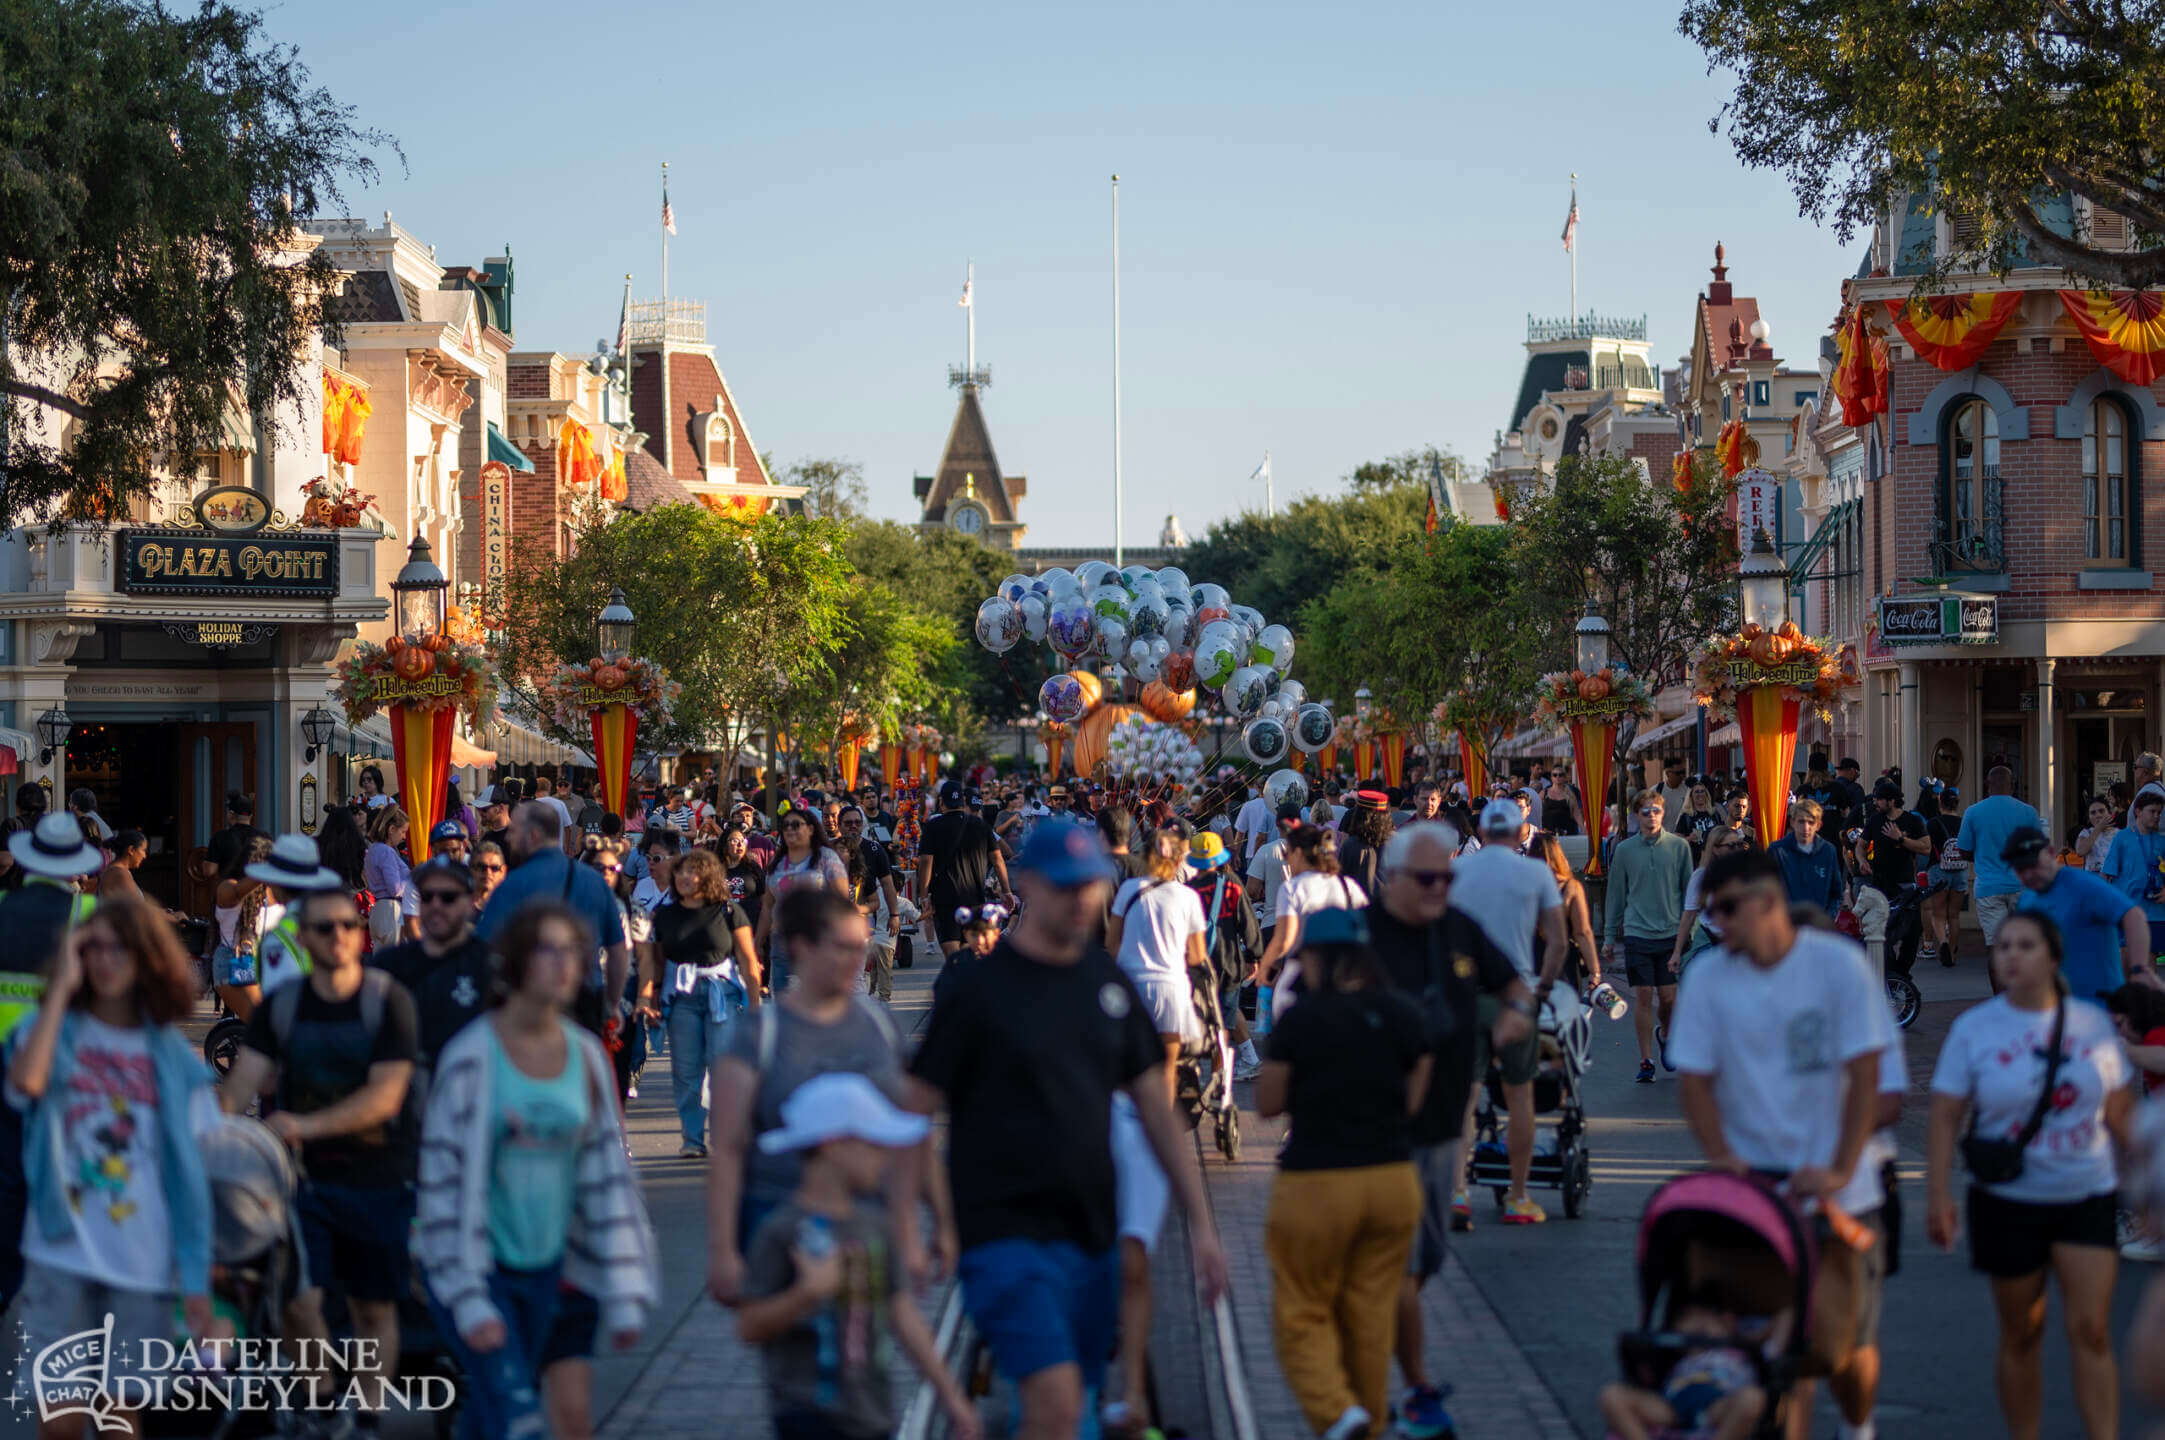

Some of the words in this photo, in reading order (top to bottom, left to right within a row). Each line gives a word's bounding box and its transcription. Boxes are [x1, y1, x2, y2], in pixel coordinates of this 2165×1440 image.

[489, 484, 501, 537] CHINA
[138, 543, 233, 578] PLAZA
[238, 546, 328, 580] POINT
[198, 623, 243, 633] HOLIDAY
[1886, 608, 1938, 633] Coca-Cola
[1963, 606, 1994, 632] Coca-Cola
[200, 633, 242, 643] SHOPPE
